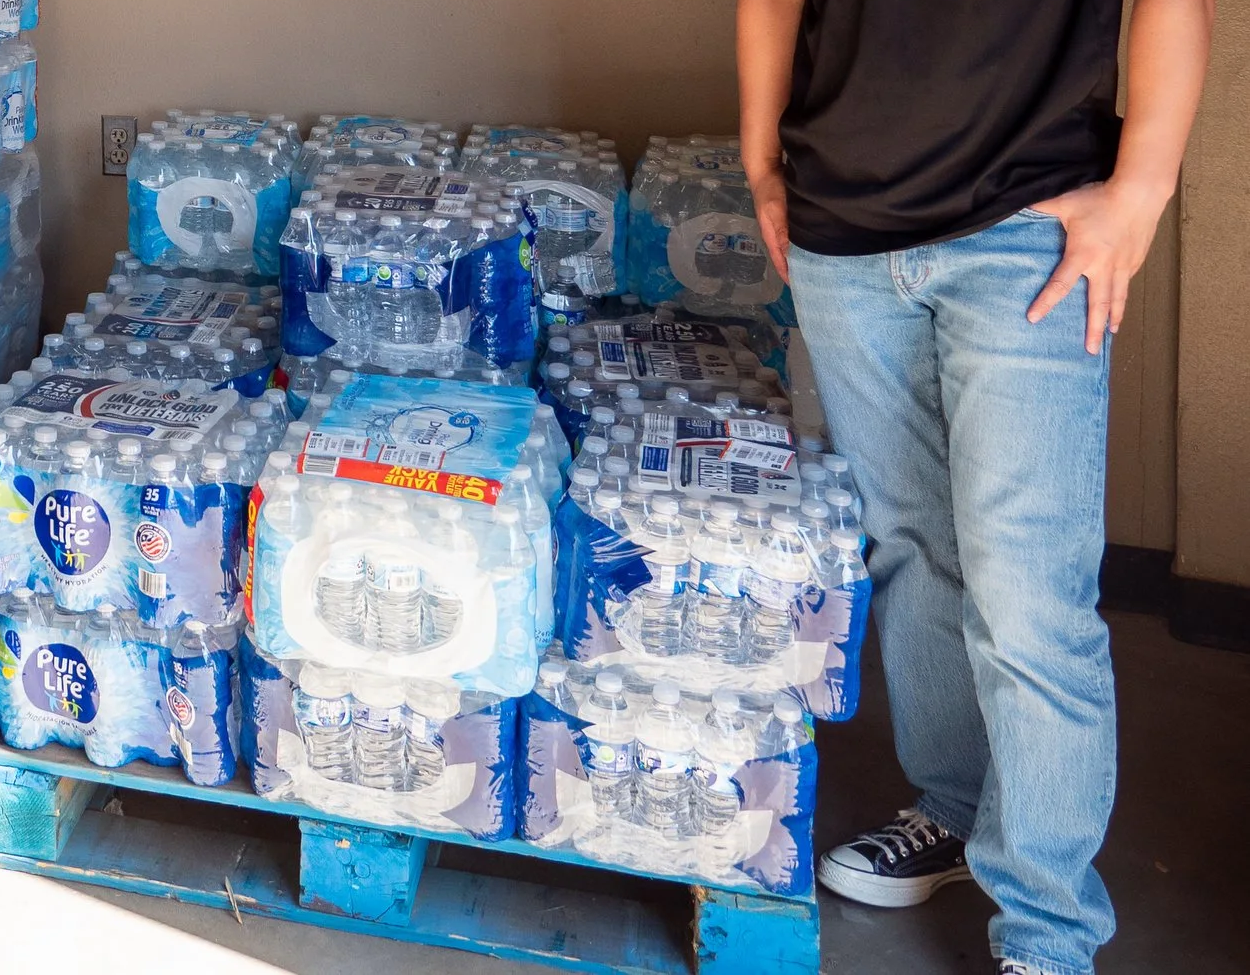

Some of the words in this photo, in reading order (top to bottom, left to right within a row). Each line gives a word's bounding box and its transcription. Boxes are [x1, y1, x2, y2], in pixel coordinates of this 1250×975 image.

[37, 388, 75, 399] YEARS
[39, 381, 83, 394] 250
[107, 393, 172, 408] UNLOCK
[171, 402, 218, 414] GOOD
[123, 405, 210, 423] VETERANS
[389, 465, 440, 479] PACK
[383, 474, 438, 493] VALUE
[462, 476, 488, 501] 40
[144, 488, 160, 502] 35
[46, 496, 97, 524] Pure
[50, 519, 91, 550] Life
[37, 648, 87, 681] Pure
[44, 671, 83, 699] Life
